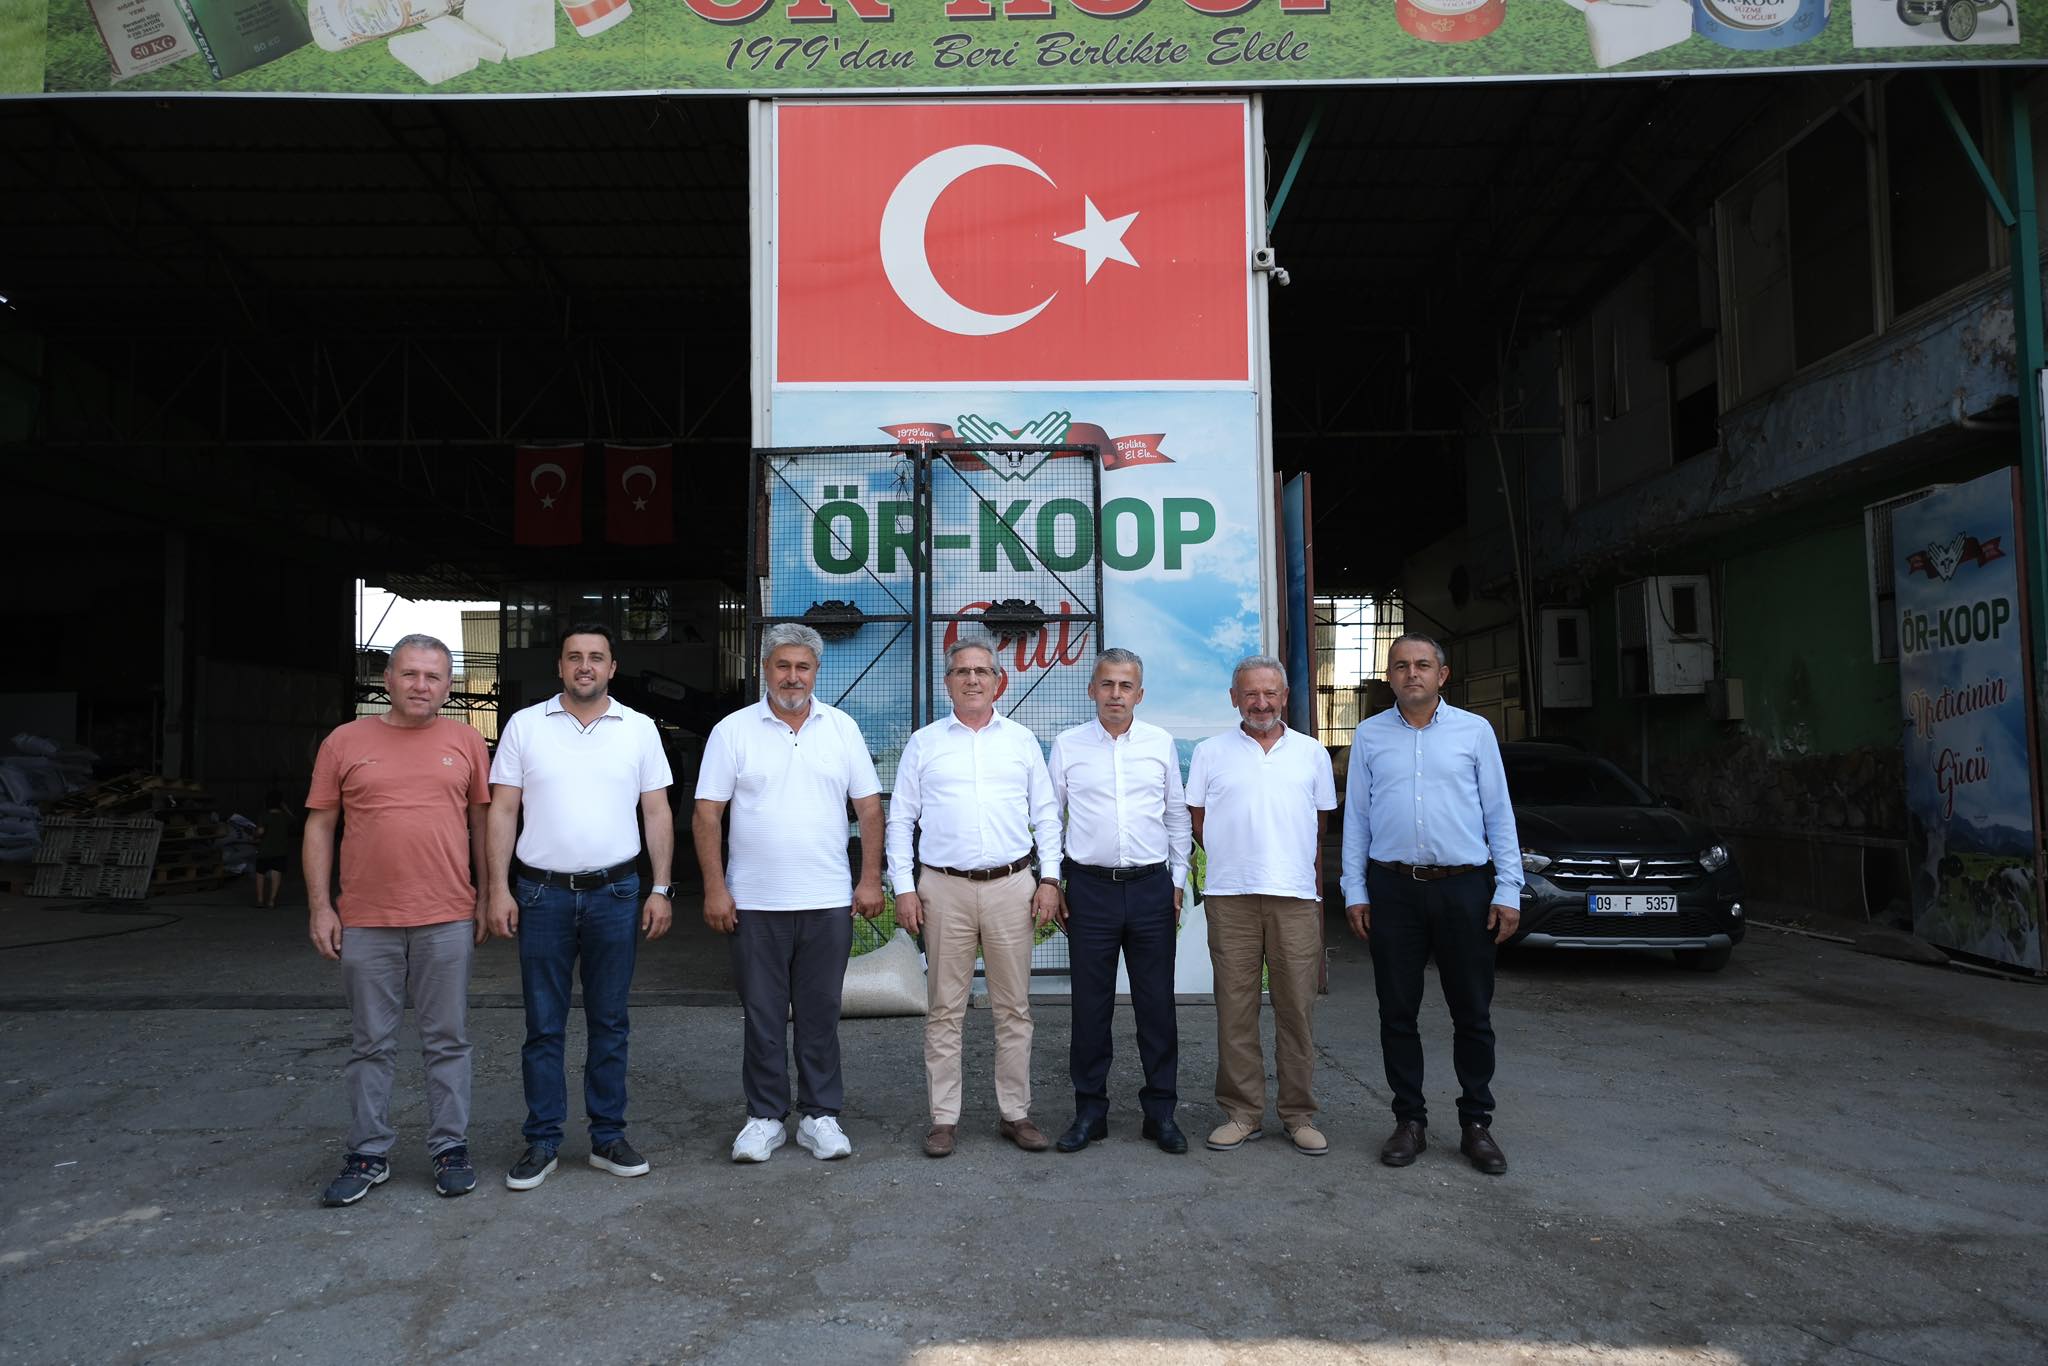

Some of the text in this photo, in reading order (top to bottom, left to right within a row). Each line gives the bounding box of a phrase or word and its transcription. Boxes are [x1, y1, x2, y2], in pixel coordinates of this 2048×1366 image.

[134, 37, 174, 59] 50 KG
[725, 26, 1311, 70] 1979'dan Beri Birlikte Elele
[897, 428, 934, 437] 1979'dan
[1116, 440, 1146, 451] Birlikte
[1125, 450, 1136, 460] El
[813, 485, 1216, 574] ÖR-KOOP
[1903, 598, 2010, 653] ÖR-KOOP
[1933, 747, 1989, 819] Gücü
[1597, 897, 1611, 910] 09
[1625, 897, 1632, 910] F
[1646, 897, 1675, 910] 5357
